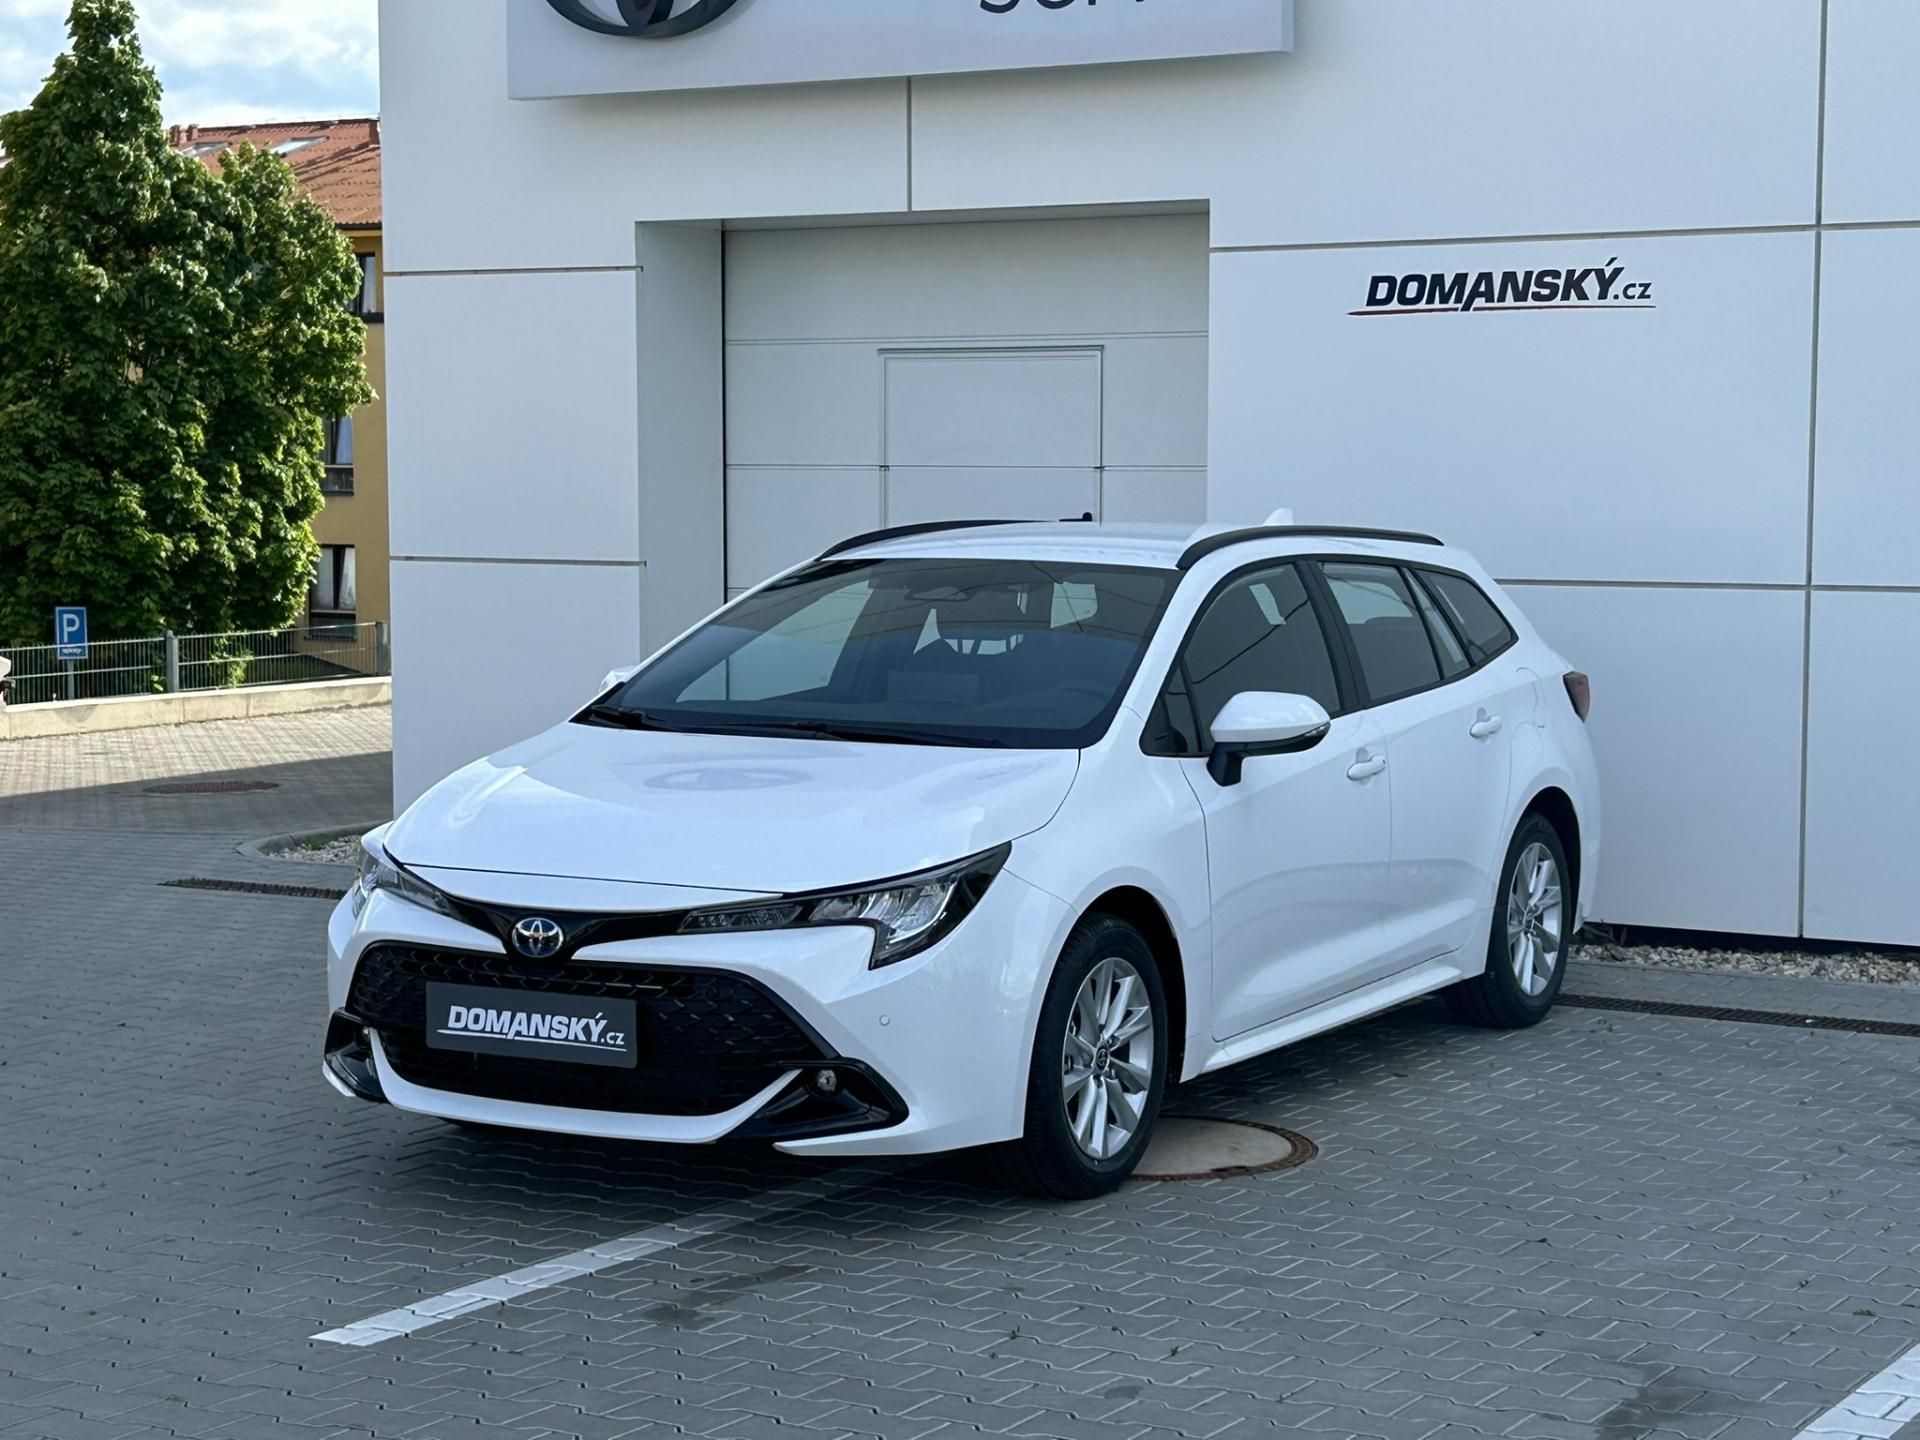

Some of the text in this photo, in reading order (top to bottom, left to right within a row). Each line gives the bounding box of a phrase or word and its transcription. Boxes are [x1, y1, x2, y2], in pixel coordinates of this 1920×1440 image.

[1366, 257, 1652, 311] DOMANSKÝ.cz
[62, 613, 80, 643] P
[447, 1005, 625, 1045] DOMANSKÝ.cz
